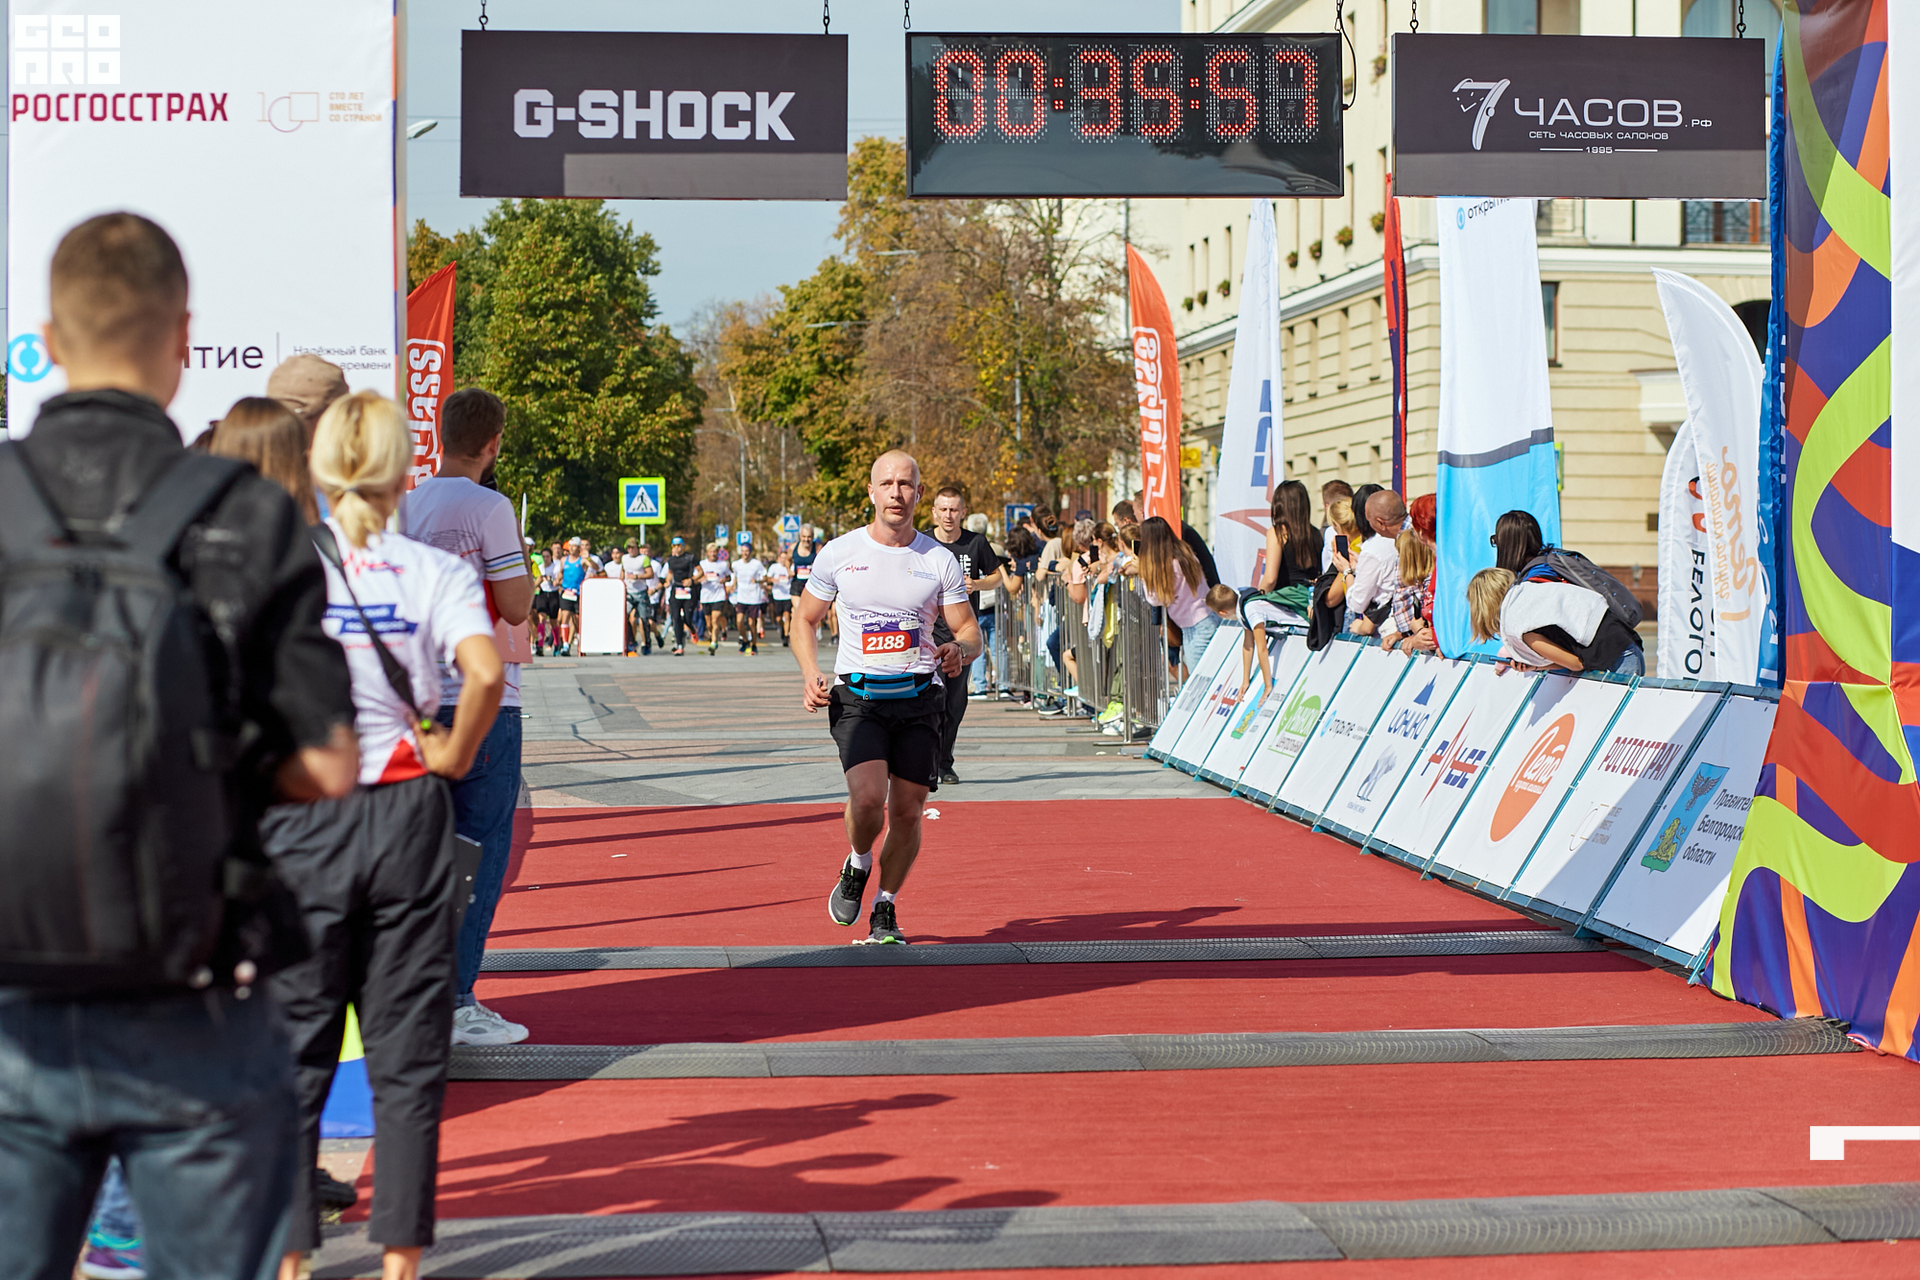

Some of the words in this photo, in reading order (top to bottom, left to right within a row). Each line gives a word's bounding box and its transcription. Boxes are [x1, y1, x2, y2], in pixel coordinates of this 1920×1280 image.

[934, 50, 1318, 138] 00:35:57
[12, 93, 228, 121] РОСГОССТРАХ
[513, 88, 796, 140] G-SHOCK
[1528, 131, 1556, 139] СЕТЬ
[1559, 131, 1613, 139] ЧАСОВЫХ
[1616, 132, 1669, 140] САЛОНОВ
[1585, 146, 1613, 154] 1995
[360, 345, 387, 356] банк
[866, 634, 905, 651] 2188
[1597, 736, 1684, 781] РОСГОССТРАХ
[1682, 842, 1717, 866] области
